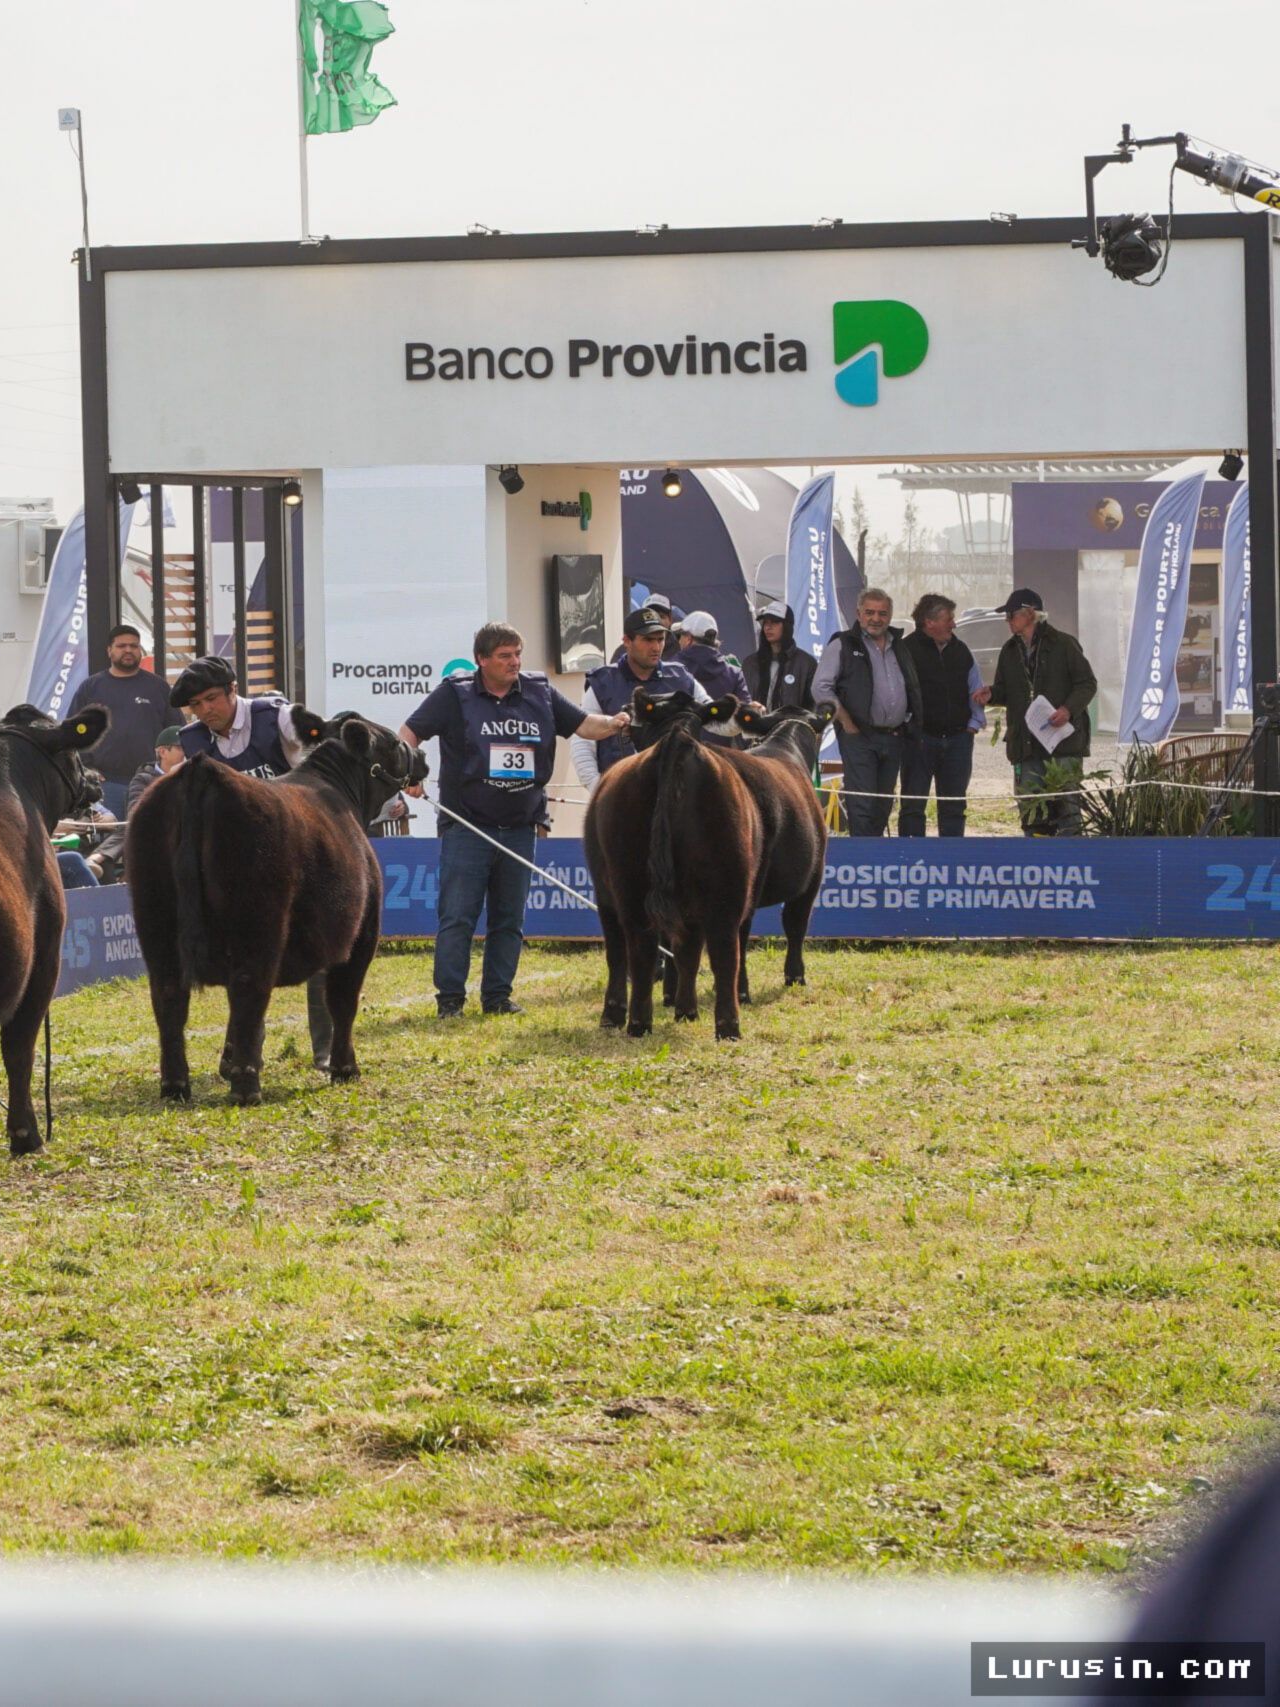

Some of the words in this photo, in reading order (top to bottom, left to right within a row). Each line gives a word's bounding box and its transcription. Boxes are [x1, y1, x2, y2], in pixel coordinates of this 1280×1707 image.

[405, 341, 554, 382] Banco
[567, 332, 807, 379] Provincia
[1156, 522, 1175, 613] POURTAU
[1170, 572, 1179, 590] NEW
[1150, 618, 1165, 683] OSCAR
[332, 662, 433, 684] Procampo
[372, 681, 432, 695] DIGITAL
[480, 719, 540, 736] ANGUS
[503, 752, 525, 769] 33
[821, 858, 948, 885] POSICIÓN
[956, 865, 1099, 885] NACIONAL
[812, 888, 877, 908] GUS
[884, 889, 920, 908] DE
[927, 889, 1096, 909] PRIMAVERA
